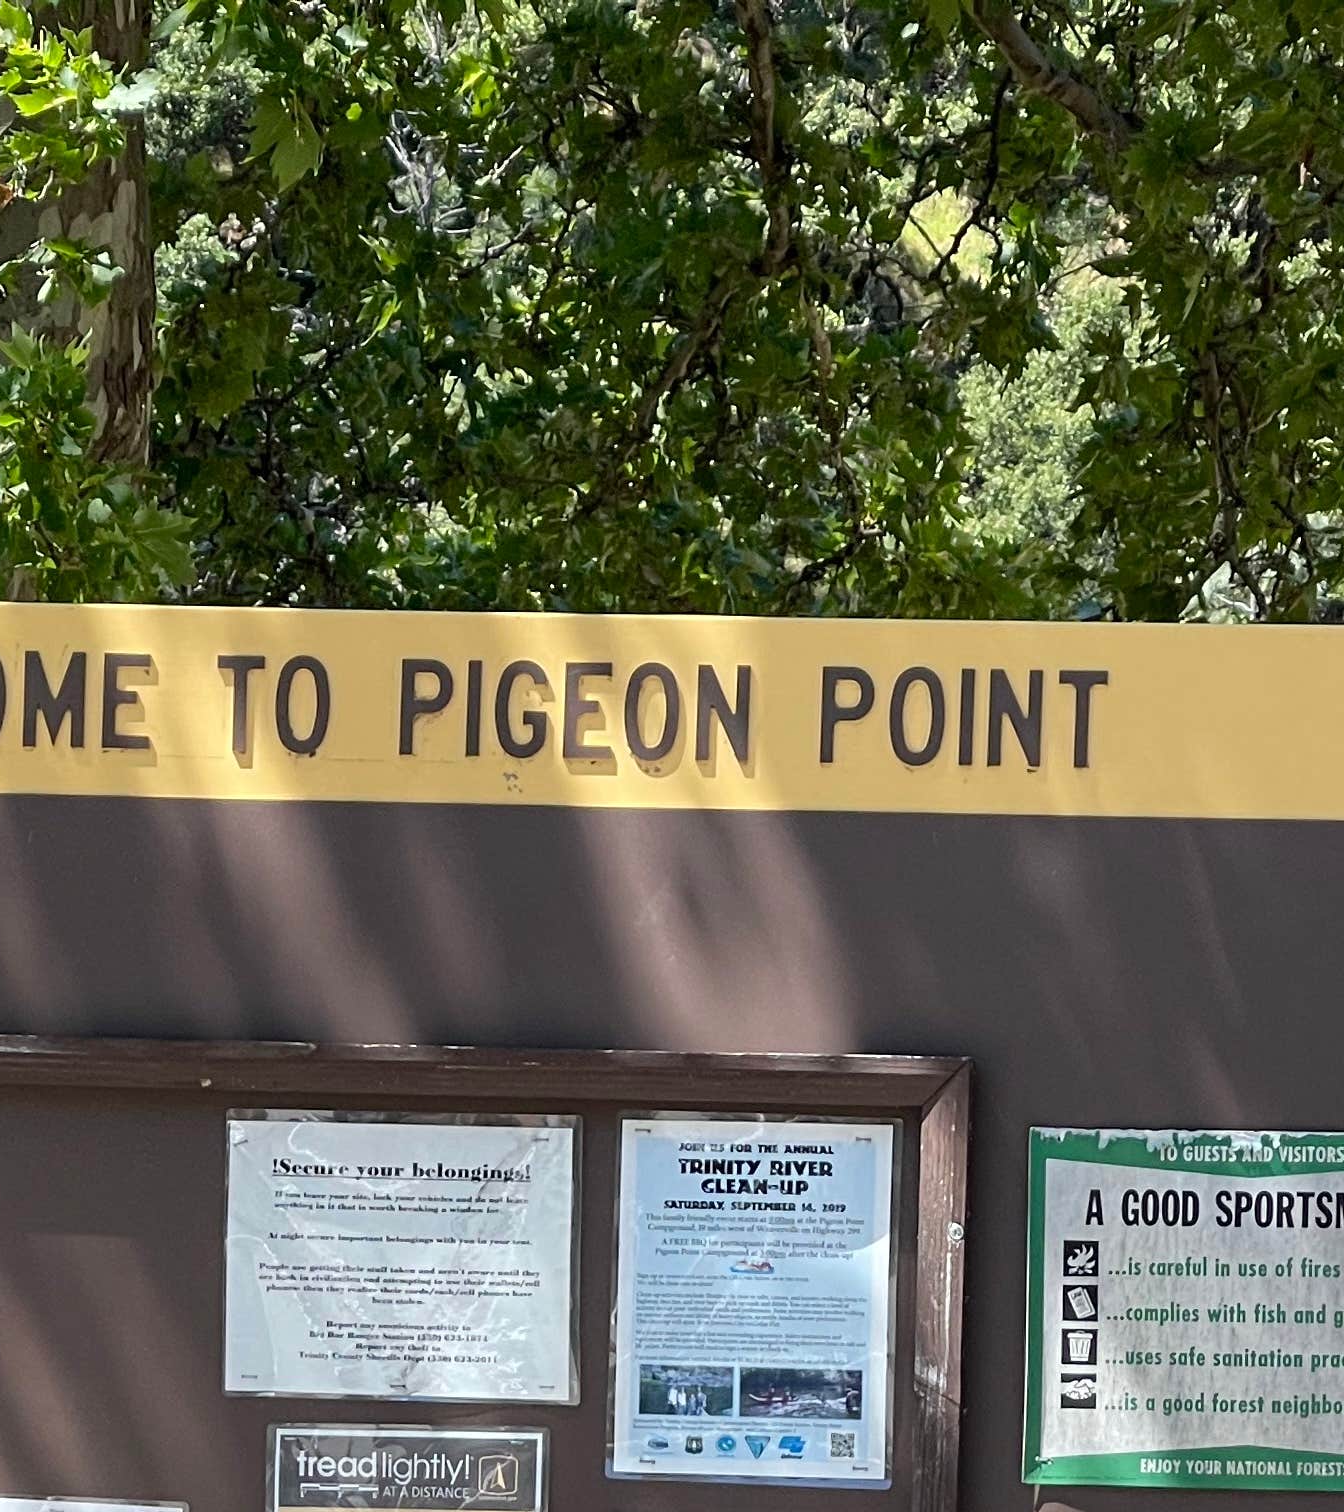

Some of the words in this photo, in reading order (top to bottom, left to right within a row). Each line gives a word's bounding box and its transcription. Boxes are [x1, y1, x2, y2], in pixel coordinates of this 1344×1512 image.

[217, 654, 332, 756] TO
[398, 658, 753, 763] PIGEON
[819, 665, 1110, 769] POINT
[679, 1142, 704, 1152] JOIN
[710, 1143, 724, 1152] US
[730, 1143, 753, 1153] FOR
[758, 1144, 778, 1154] THE
[784, 1144, 834, 1155] ANNUAL
[1159, 1145, 1177, 1162] TO
[1183, 1145, 1237, 1163] GUESTS
[1242, 1146, 1273, 1163] AND
[1278, 1146, 1344, 1164] VISITORS
[357, 1165, 405, 1181] your
[678, 1158, 762, 1176] TRINITY
[770, 1160, 834, 1177] RIVER
[701, 1178, 809, 1196] CLEAN-UP
[664, 1200, 725, 1212] SATURDAY,
[730, 1201, 796, 1212] SEPTEMBER
[822, 1203, 847, 1213] 2019
[1085, 1189, 1104, 1226] A
[1121, 1189, 1200, 1227] GOOD
[1149, 1256, 1208, 1278] careful
[1215, 1256, 1231, 1277] in
[1238, 1261, 1267, 1278] use
[1275, 1256, 1294, 1278] of
[1300, 1257, 1341, 1278] fires
[1106, 1301, 1199, 1327] ...complies
[1207, 1302, 1246, 1324] with
[1254, 1302, 1286, 1325] fish
[1293, 1304, 1325, 1325] and
[1105, 1349, 1162, 1367] ...uses
[1169, 1346, 1205, 1367] safe
[1213, 1347, 1303, 1369] sanitation
[1146, 1397, 1155, 1411] a
[1162, 1392, 1204, 1416] good
[1212, 1392, 1264, 1413] forest
[1140, 1457, 1182, 1475] ENJOY
[1185, 1459, 1222, 1475] YOUR
[1226, 1459, 1293, 1477] NATIONAL
[383, 1486, 396, 1498] AT
[399, 1486, 409, 1498] A
[412, 1487, 470, 1499] DISTANCE
